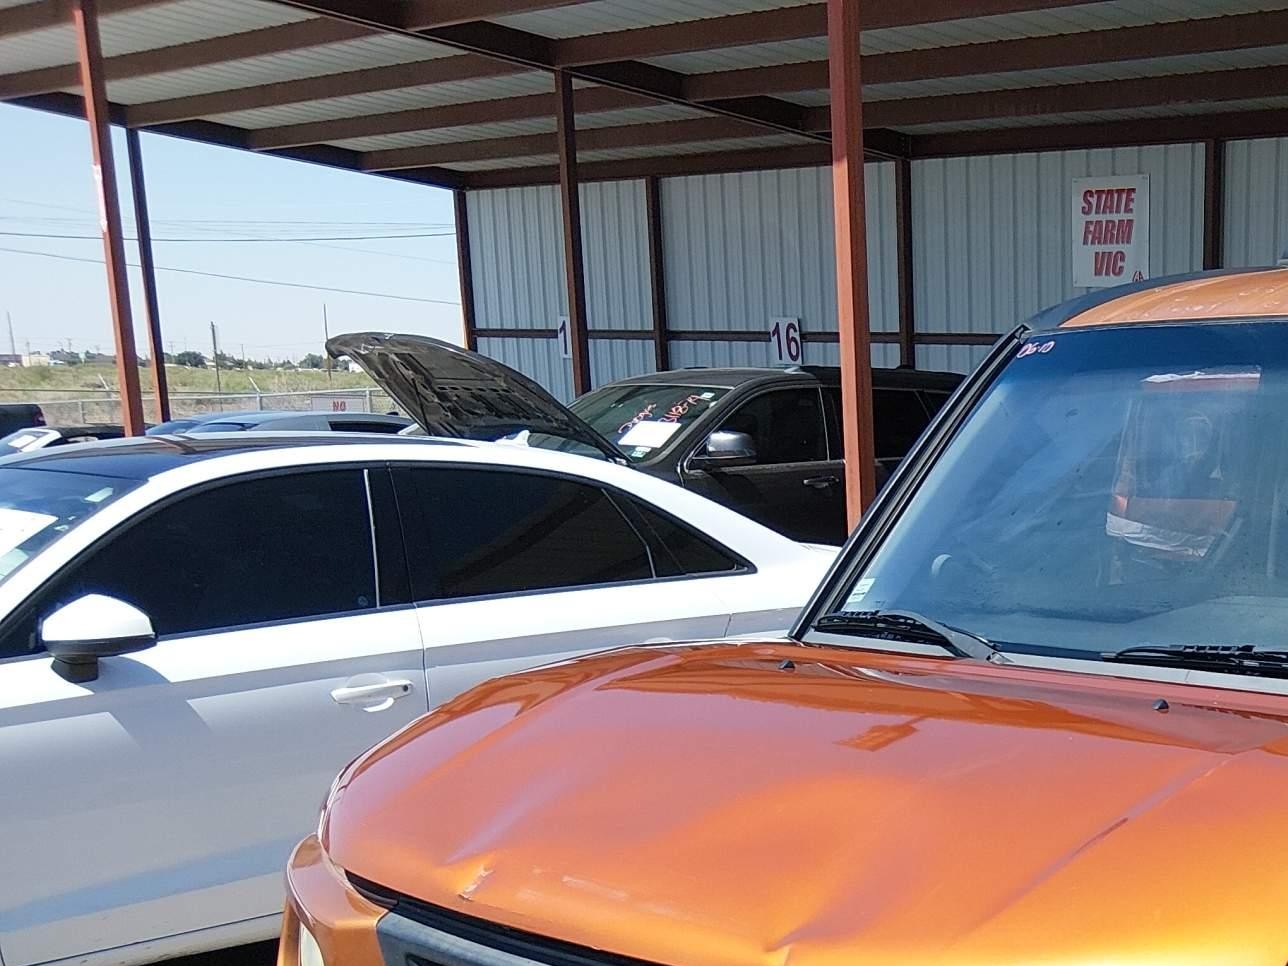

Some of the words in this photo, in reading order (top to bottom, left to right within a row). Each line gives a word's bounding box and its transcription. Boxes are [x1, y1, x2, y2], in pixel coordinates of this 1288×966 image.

[1082, 188, 1136, 215] STATE
[1083, 219, 1134, 245] FARM
[1094, 251, 1126, 276] VIC
[772, 322, 800, 361] 16
